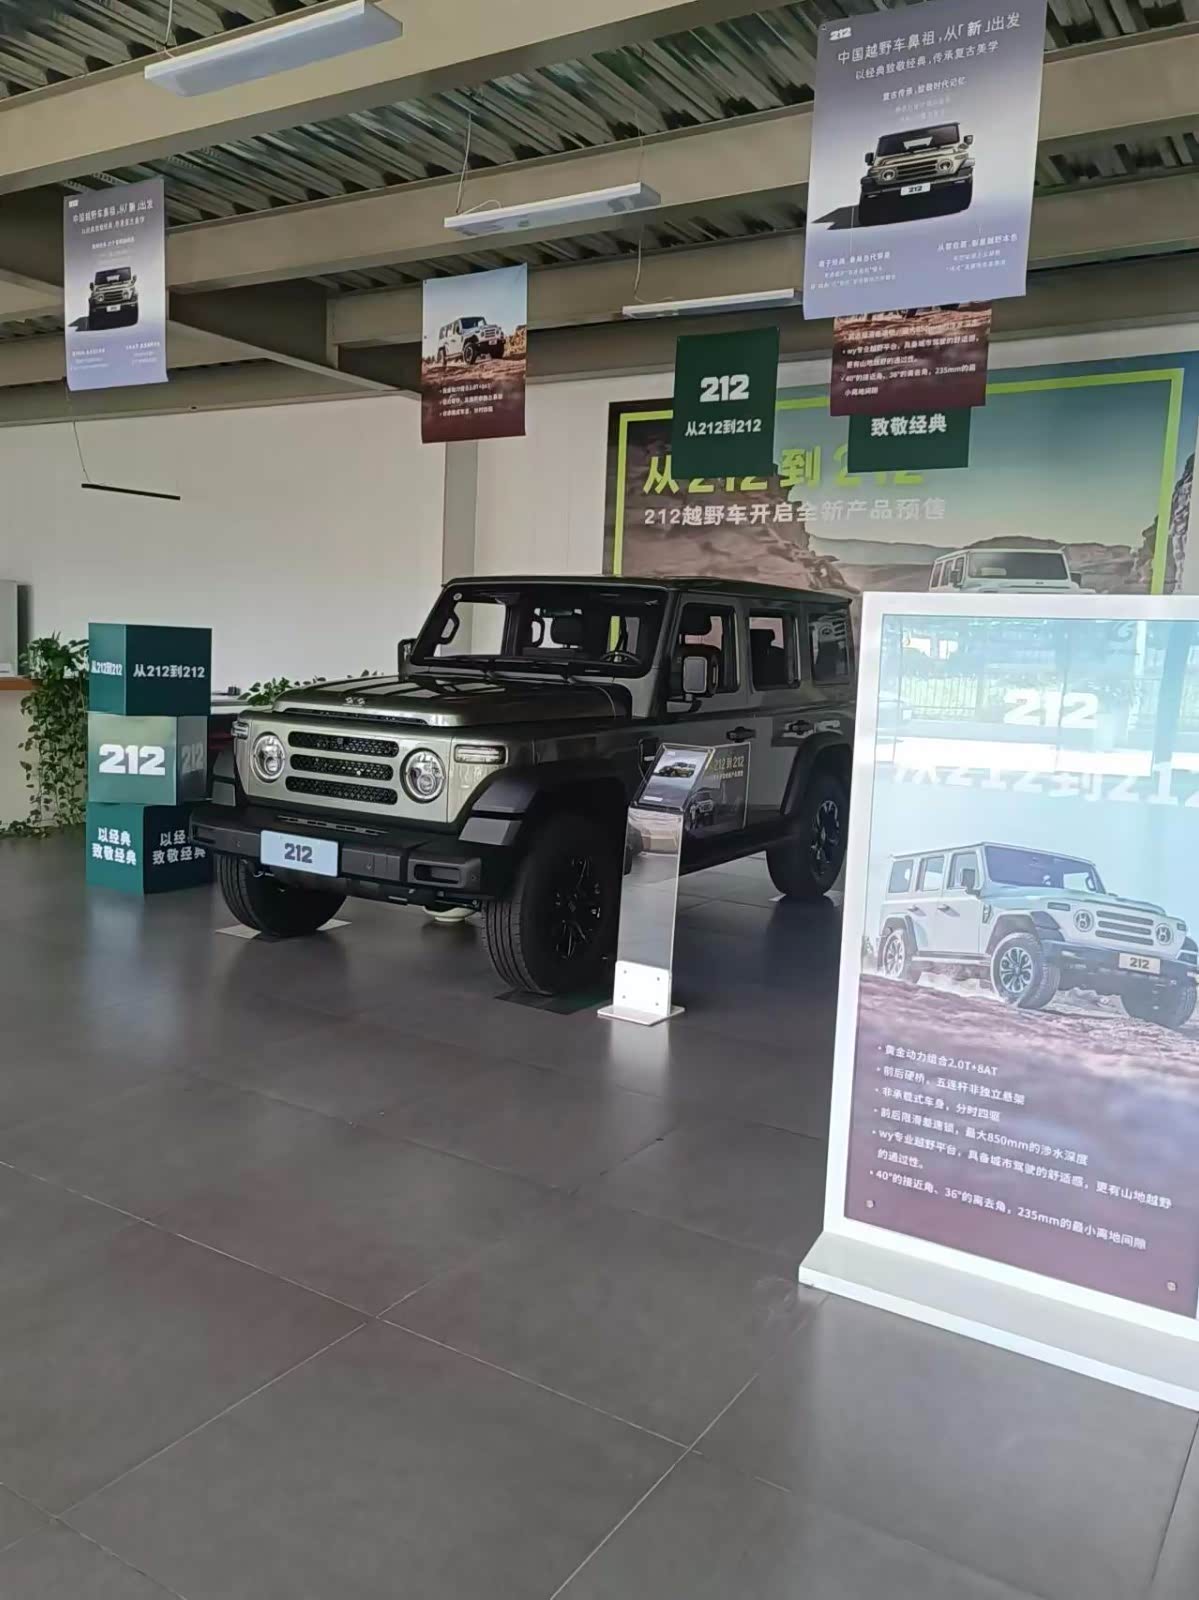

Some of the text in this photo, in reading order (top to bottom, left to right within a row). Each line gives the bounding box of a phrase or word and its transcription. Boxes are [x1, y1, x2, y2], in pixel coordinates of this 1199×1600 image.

[829, 27, 851, 41] 212
[699, 374, 750, 403] 212
[684, 418, 762, 437] 从212到212
[870, 413, 947, 437] 致敬经典
[644, 498, 946, 527] 212越野车开启全新产品预售
[133, 664, 205, 678] 从212到212
[1003, 689, 1098, 729] 212
[98, 743, 166, 776] 212
[181, 742, 204, 773] 212
[97, 827, 132, 847] 以经典
[160, 829, 187, 847] 以经
[91, 843, 137, 866] 致敬经典
[284, 842, 313, 864] 212
[1129, 956, 1150, 969] 212
